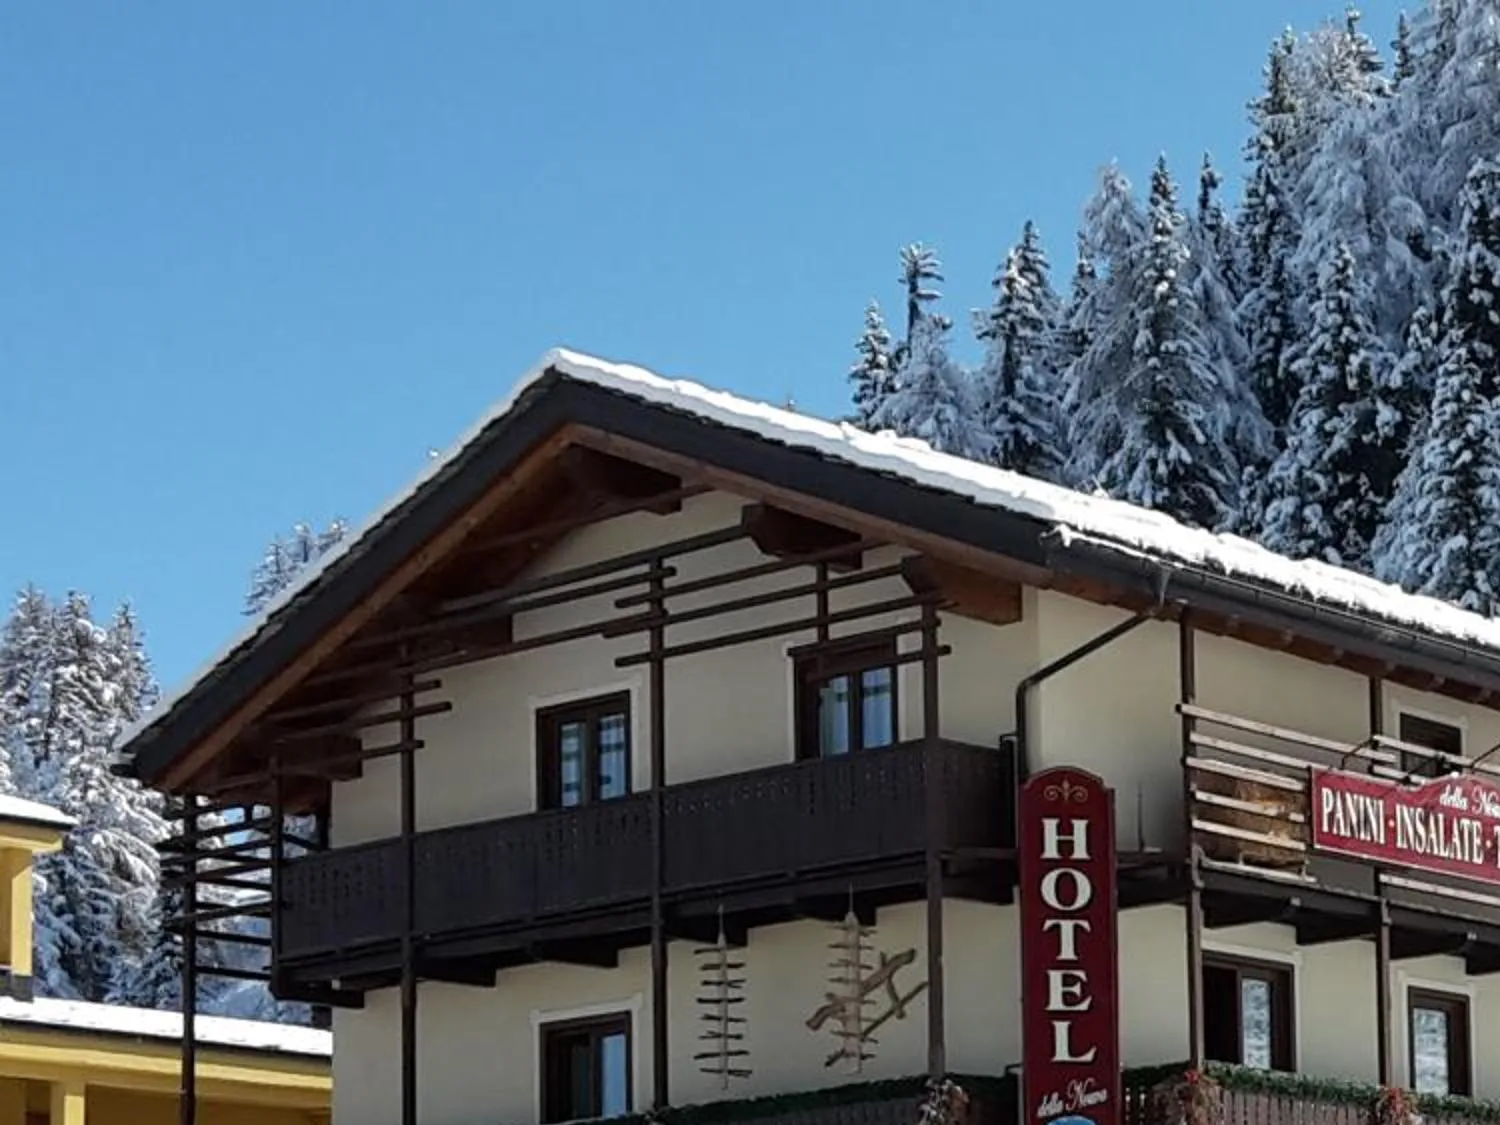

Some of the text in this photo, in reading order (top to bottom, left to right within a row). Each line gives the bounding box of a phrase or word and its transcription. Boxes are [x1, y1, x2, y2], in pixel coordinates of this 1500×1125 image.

[1321, 787, 1386, 844] PANINI
[1396, 803, 1484, 865] INSALATE
[1040, 817, 1096, 1063] HOTEL
